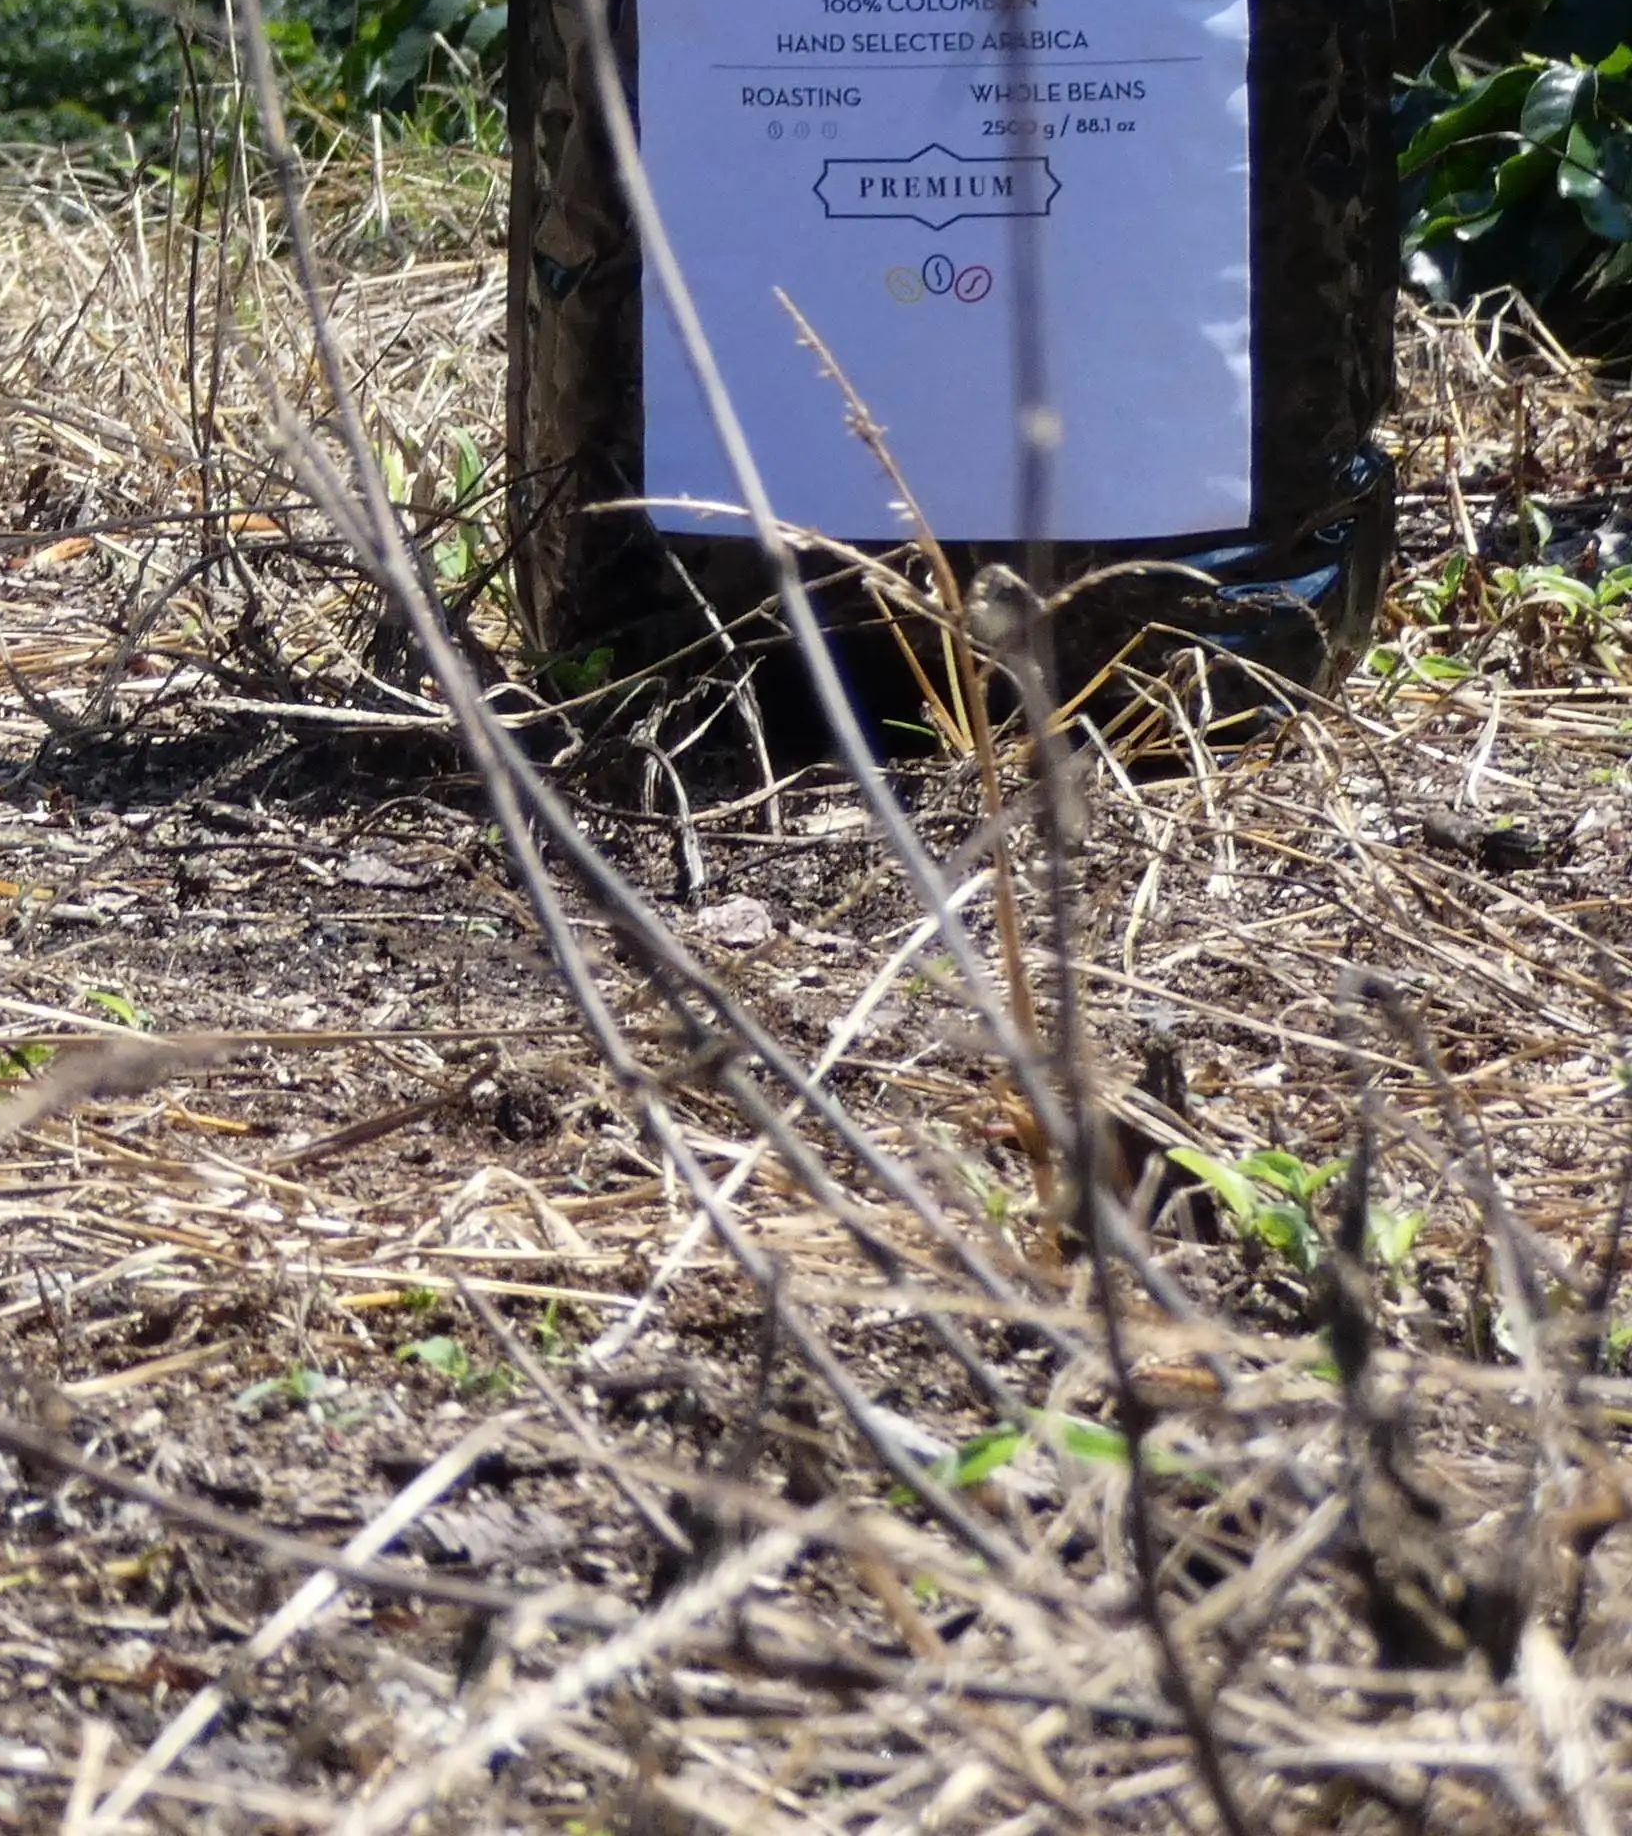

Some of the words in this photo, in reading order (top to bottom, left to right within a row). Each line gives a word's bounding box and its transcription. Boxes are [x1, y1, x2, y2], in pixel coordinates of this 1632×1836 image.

[777, 33, 846, 54] HAND
[852, 31, 975, 53] SELECTED
[742, 86, 862, 108] ROASTING
[970, 82, 1061, 104] WHOLE
[1068, 80, 1146, 101] BEANS
[1043, 123, 1055, 139] g
[1076, 117, 1111, 133] 88.1
[1117, 120, 1136, 133] oz
[859, 175, 1015, 199] PREMIUM
